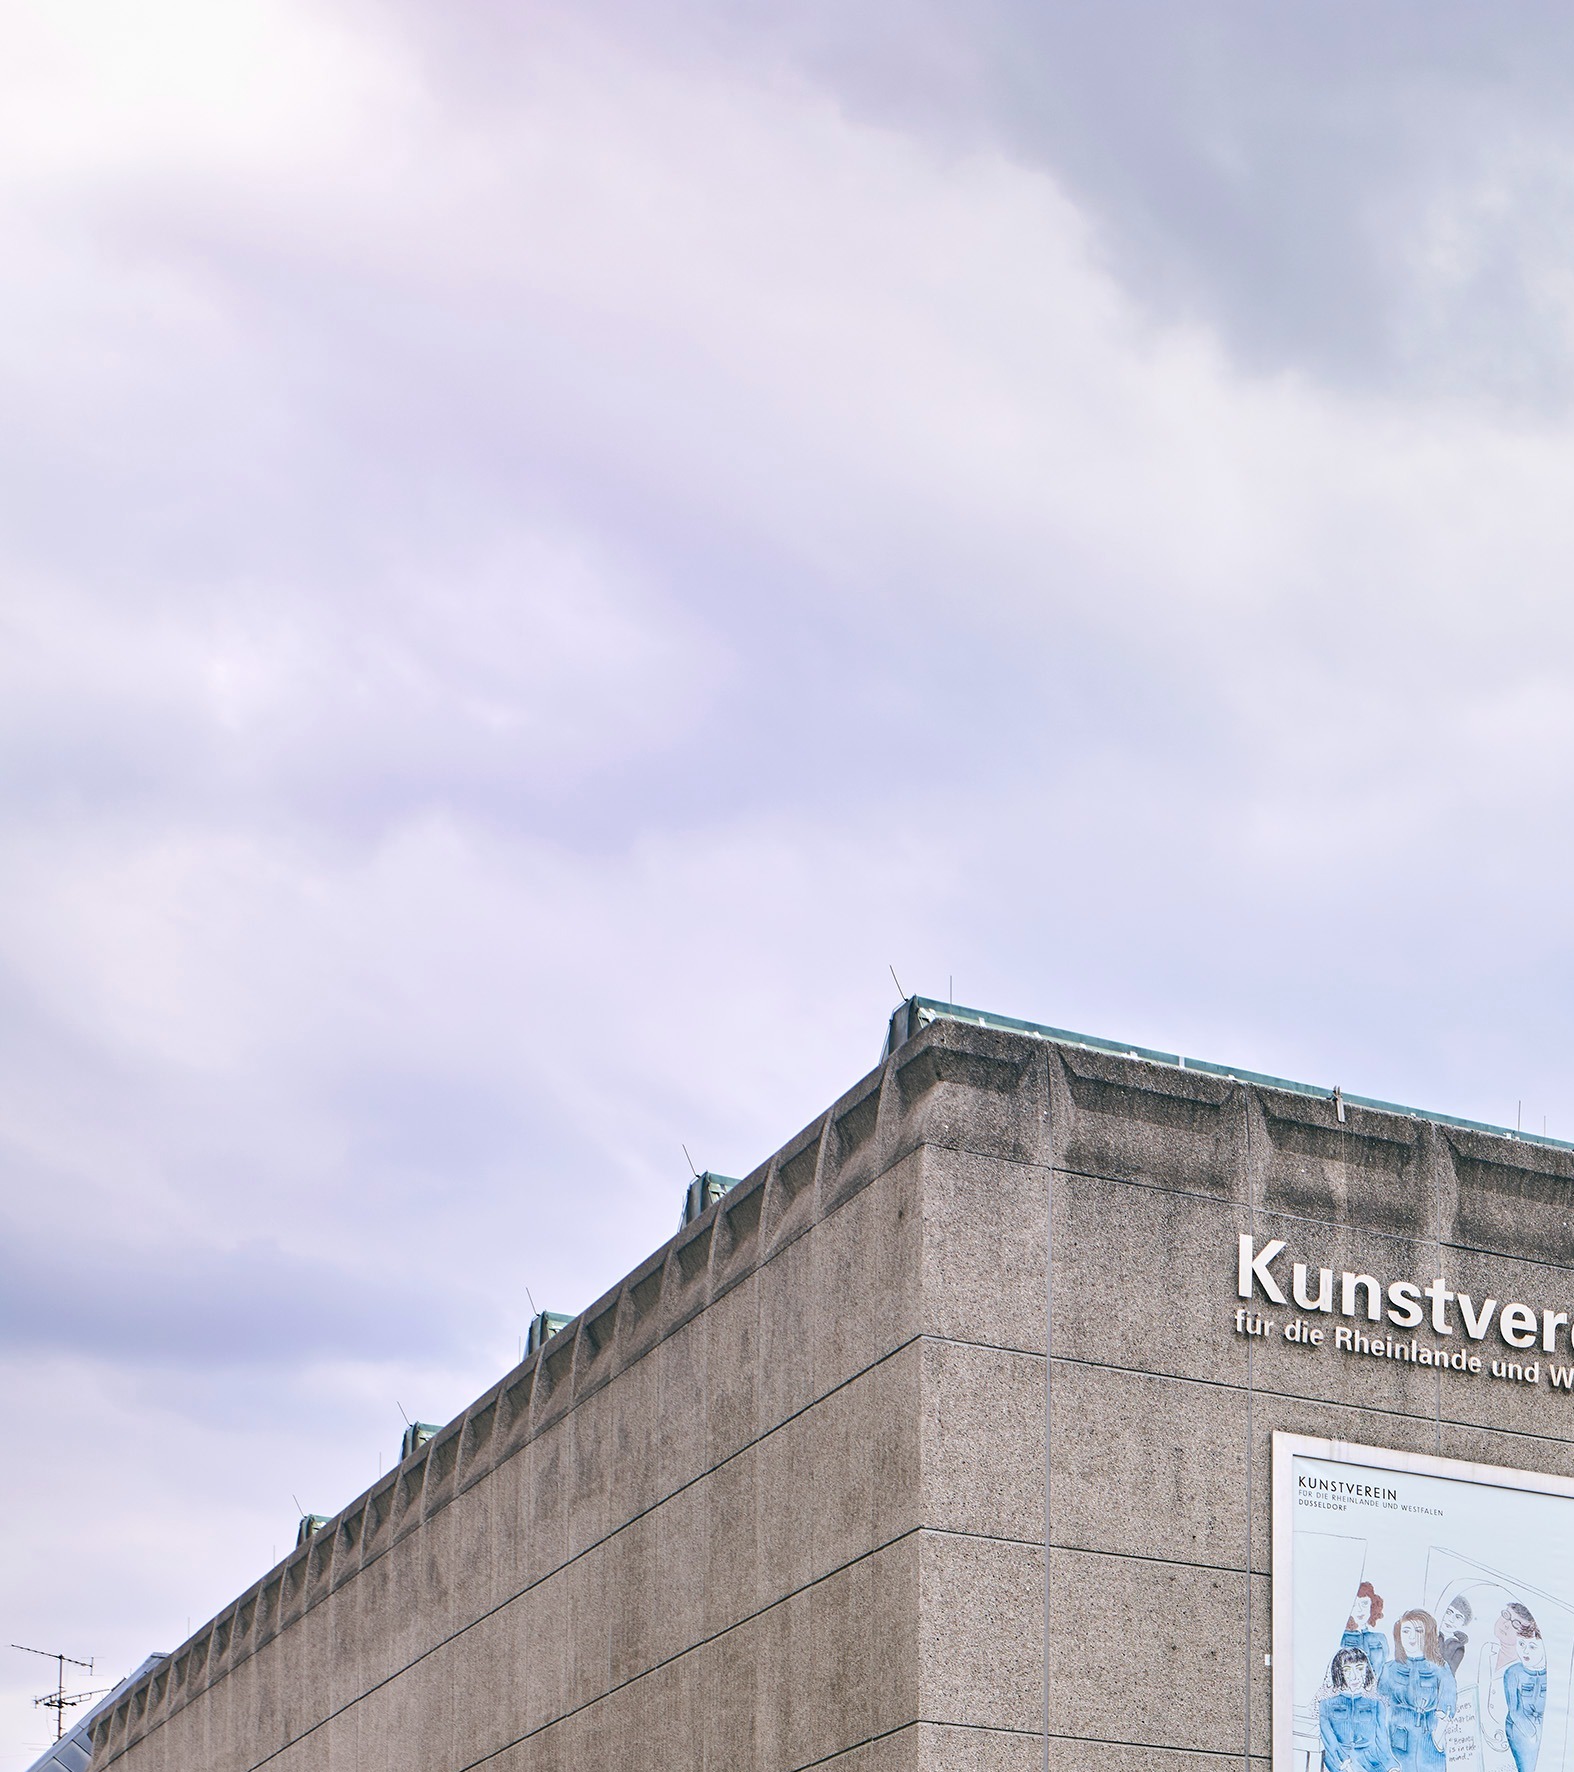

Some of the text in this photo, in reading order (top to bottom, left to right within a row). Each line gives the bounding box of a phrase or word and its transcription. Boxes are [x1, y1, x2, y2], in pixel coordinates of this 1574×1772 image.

[1234, 1309, 1275, 1337] für
[1284, 1319, 1325, 1346] die
[1334, 1326, 1482, 1373] Rheinlande
[1492, 1360, 1540, 1385] und
[1298, 1475, 1397, 1501] KUNSTVEREIN
[1298, 1489, 1444, 1516] FÜR DIE RHEINLANDE UND WESTFALEN
[1298, 1498, 1348, 1512] DÜSSELDORF
